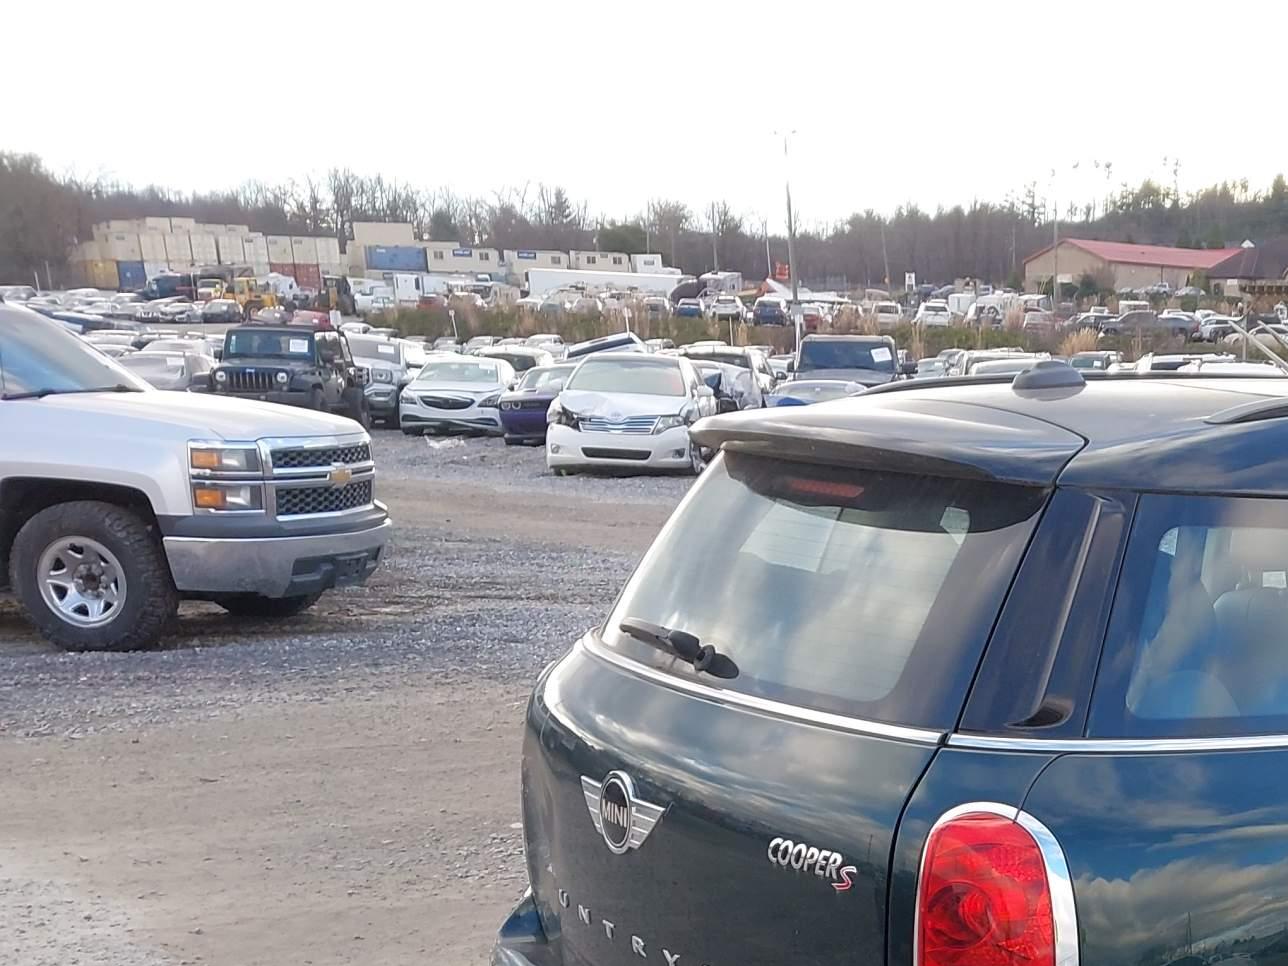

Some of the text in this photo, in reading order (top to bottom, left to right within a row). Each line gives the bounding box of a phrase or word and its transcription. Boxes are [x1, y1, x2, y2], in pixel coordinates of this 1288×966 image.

[602, 798, 628, 829] MINI
[767, 837, 857, 891] COOPER S
